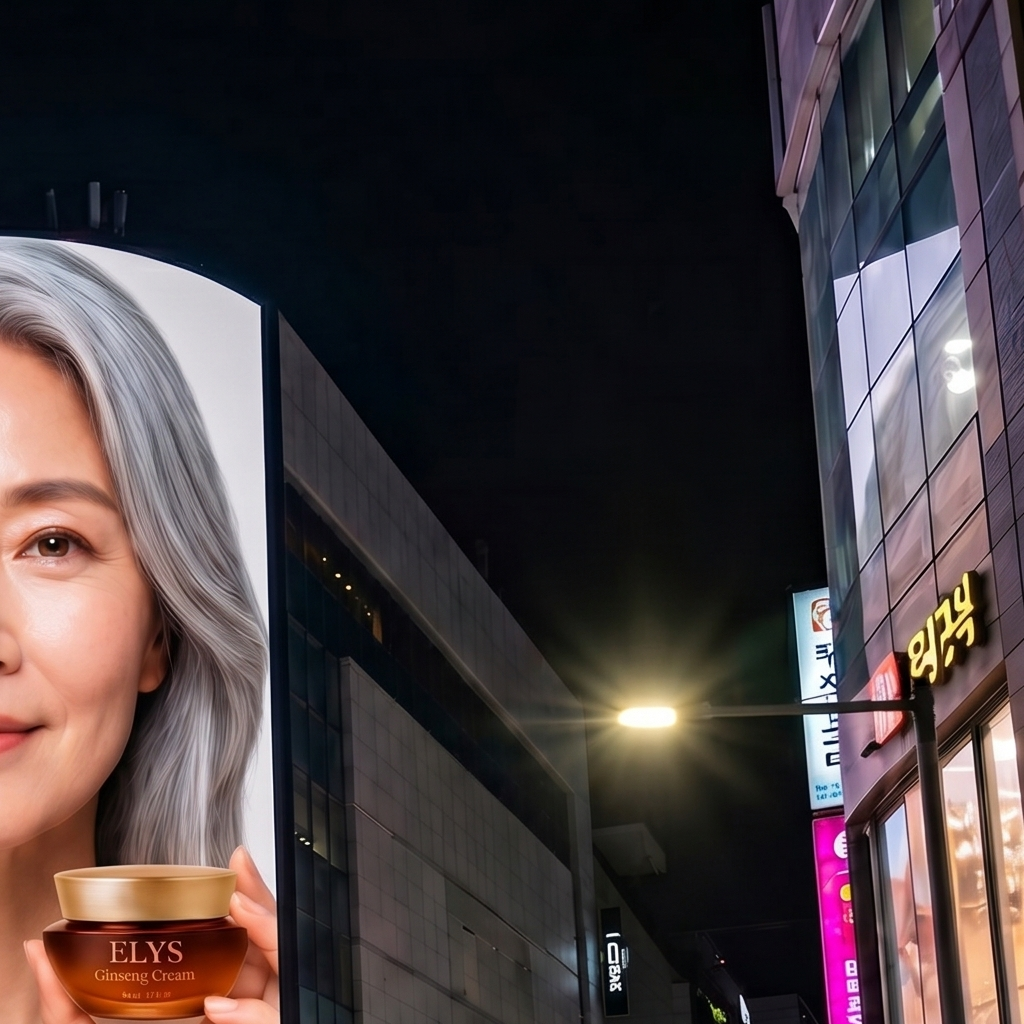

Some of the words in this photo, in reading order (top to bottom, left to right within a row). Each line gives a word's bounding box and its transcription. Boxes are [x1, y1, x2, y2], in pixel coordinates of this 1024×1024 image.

[109, 941, 183, 963] ELYS
[95, 969, 148, 985] Ginseng
[152, 969, 195, 981] Cream
